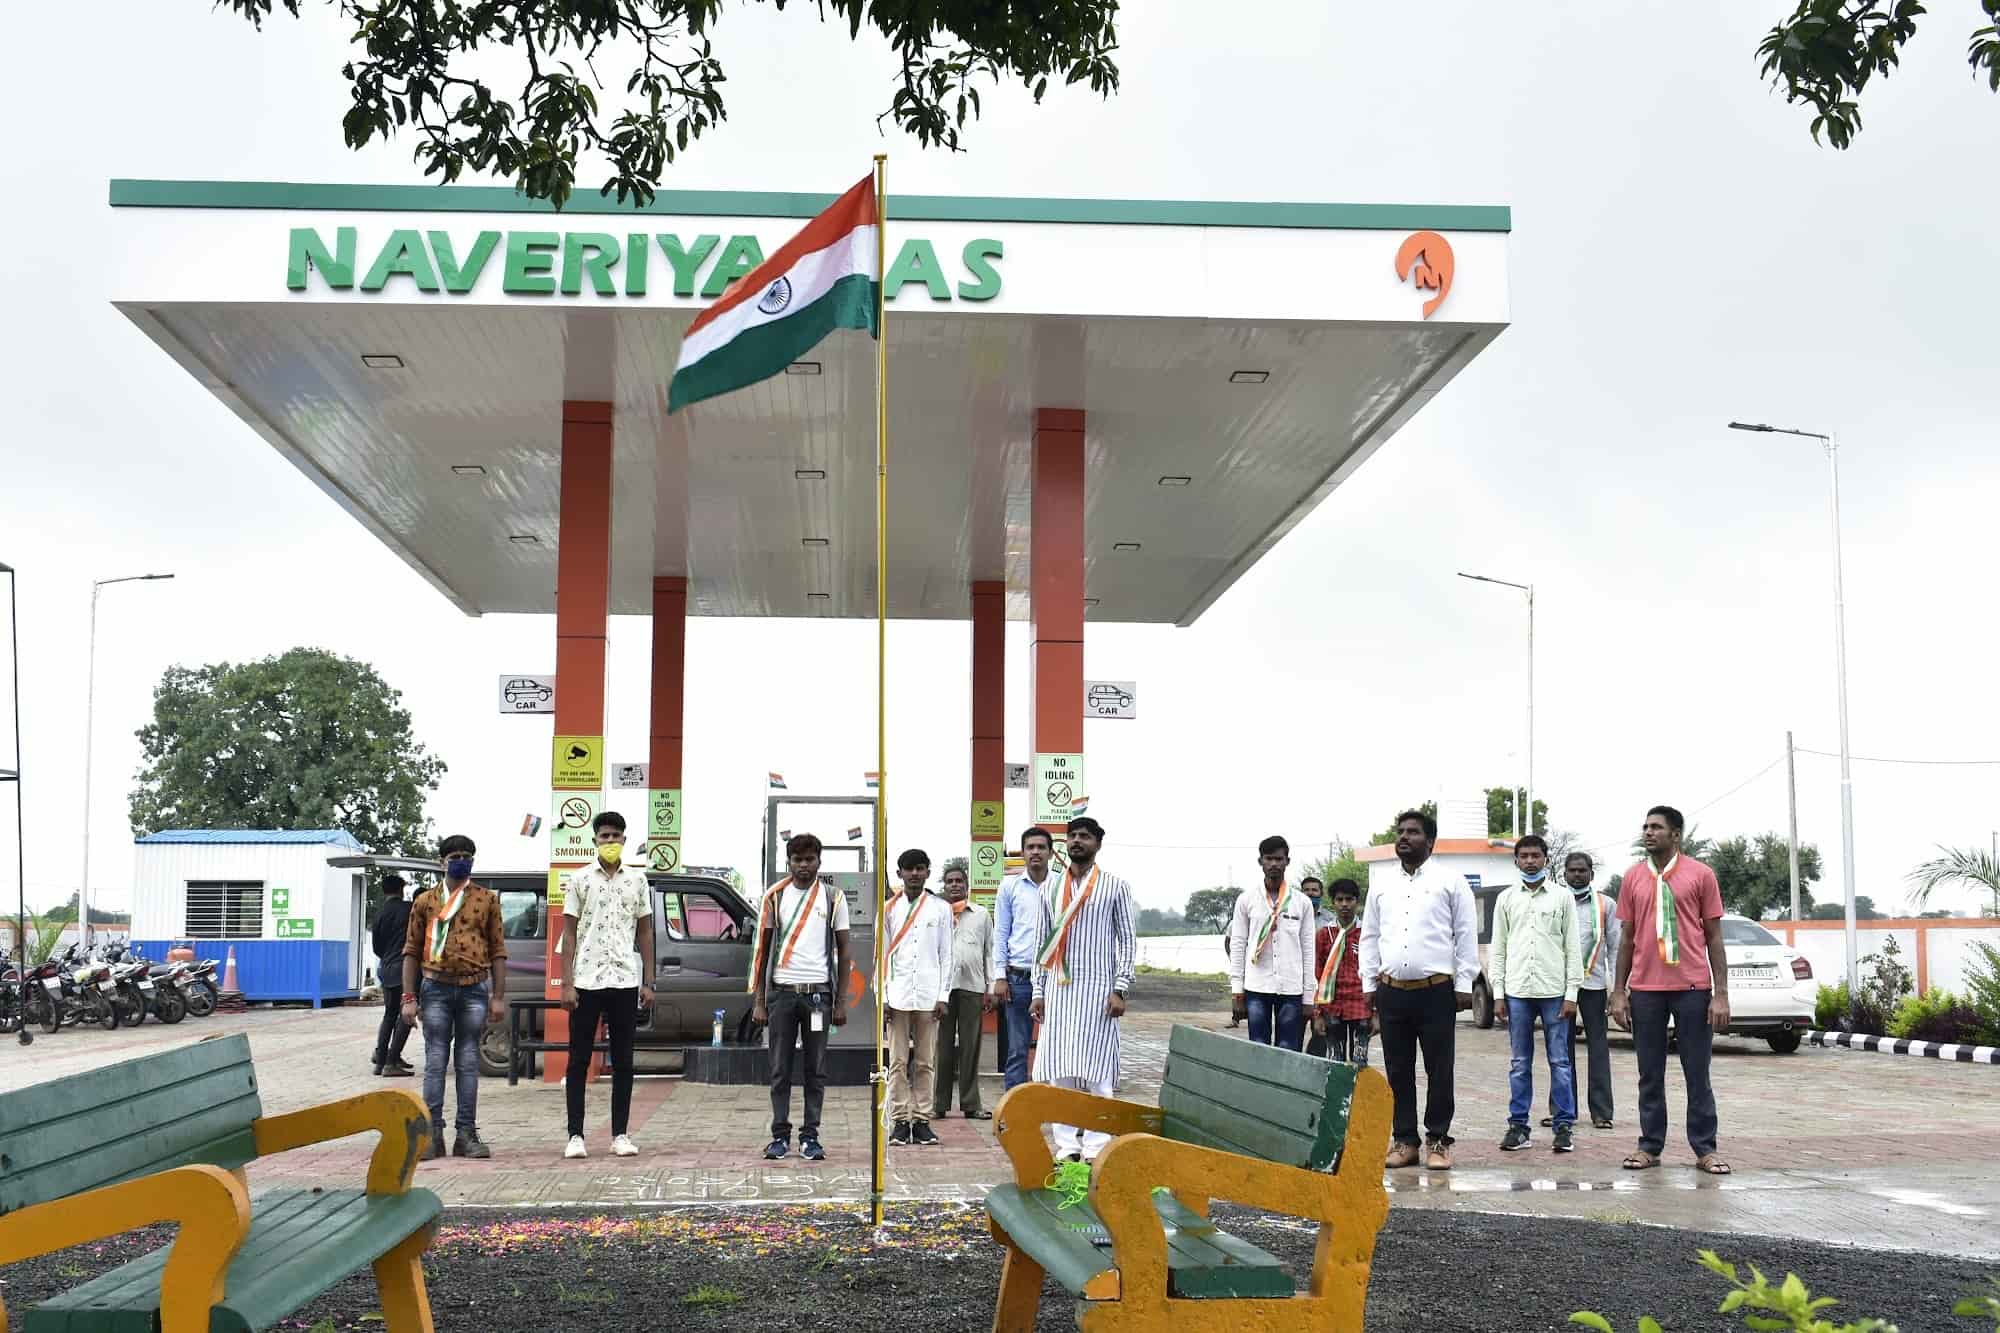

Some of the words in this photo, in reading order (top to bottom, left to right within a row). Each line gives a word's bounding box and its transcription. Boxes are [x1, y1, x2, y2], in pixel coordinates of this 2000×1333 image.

[287, 226, 767, 299] NAVERIYA
[883, 238, 1003, 301] AS
[1098, 707, 1118, 715] CAR
[1053, 758, 1066, 767] NO
[1045, 770, 1075, 780] IDLING
[660, 792, 670, 800] NO
[569, 836, 582, 844] NO
[555, 847, 596, 857] SMOKING
